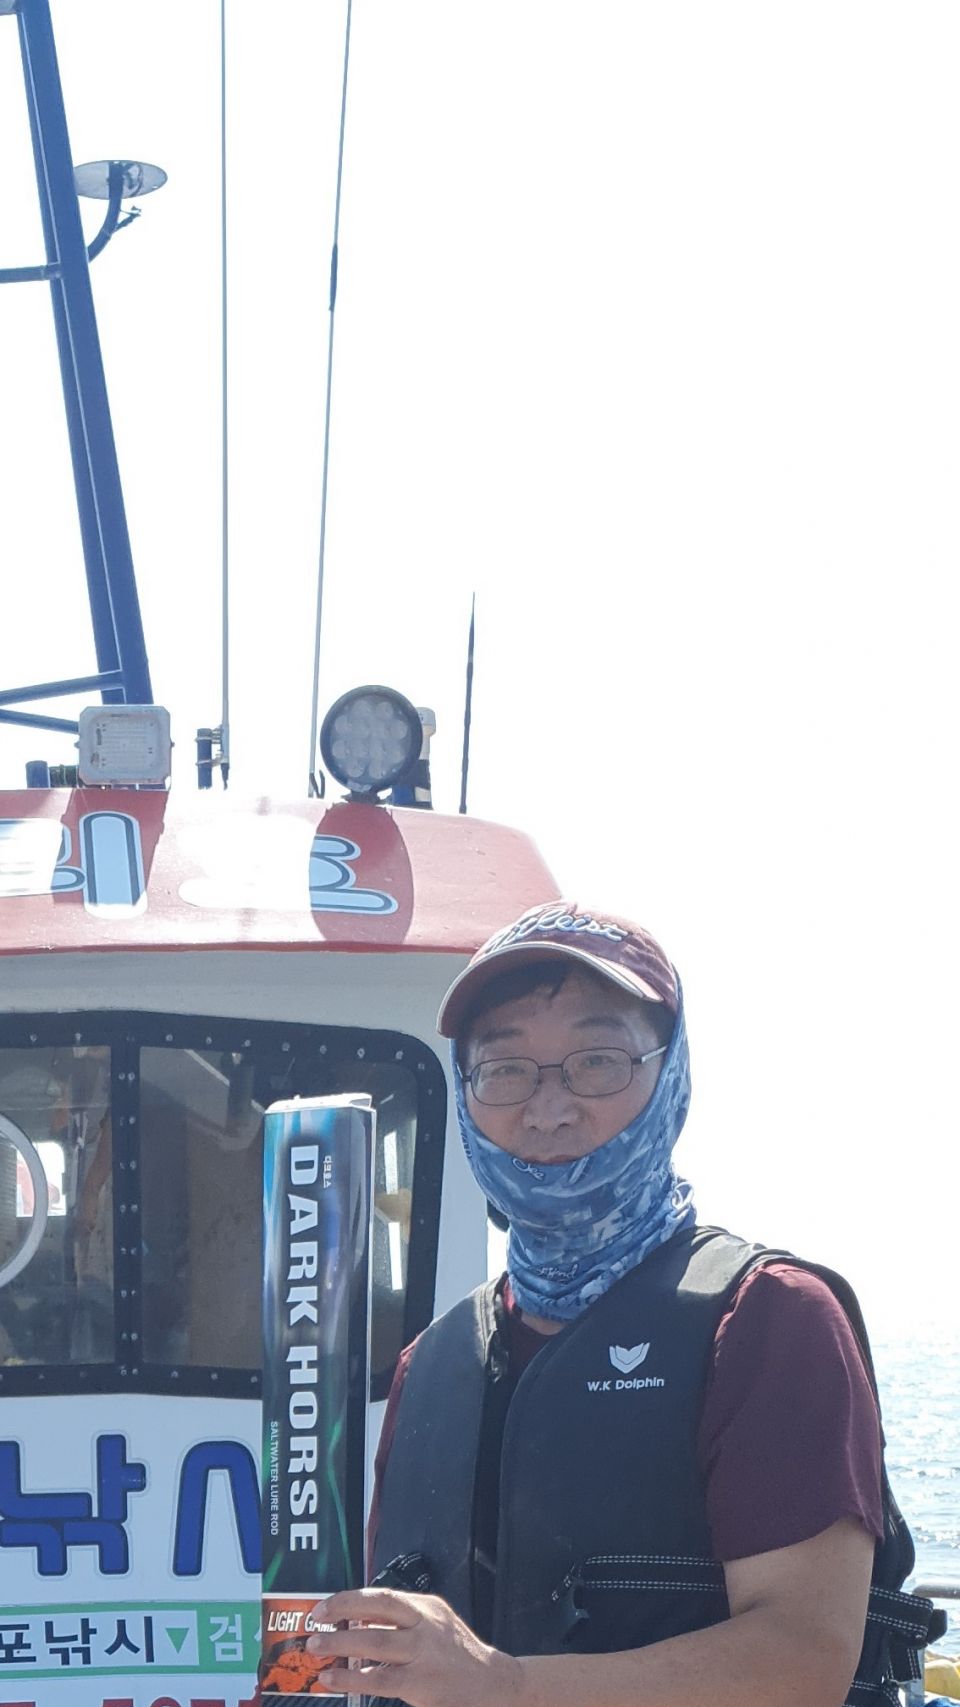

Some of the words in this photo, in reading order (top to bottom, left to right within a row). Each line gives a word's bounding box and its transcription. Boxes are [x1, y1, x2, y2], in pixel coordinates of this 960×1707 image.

[285, 1144, 319, 1325] DARK
[615, 1376, 665, 1391] Dolphin
[270, 1421, 279, 1483] SALTWATER
[285, 1344, 319, 1552] HORSE
[270, 1484, 279, 1512] LURE
[270, 1513, 279, 1536] ROD
[208, 1612, 262, 1663] 검
[267, 1611, 304, 1632] LIGHT
